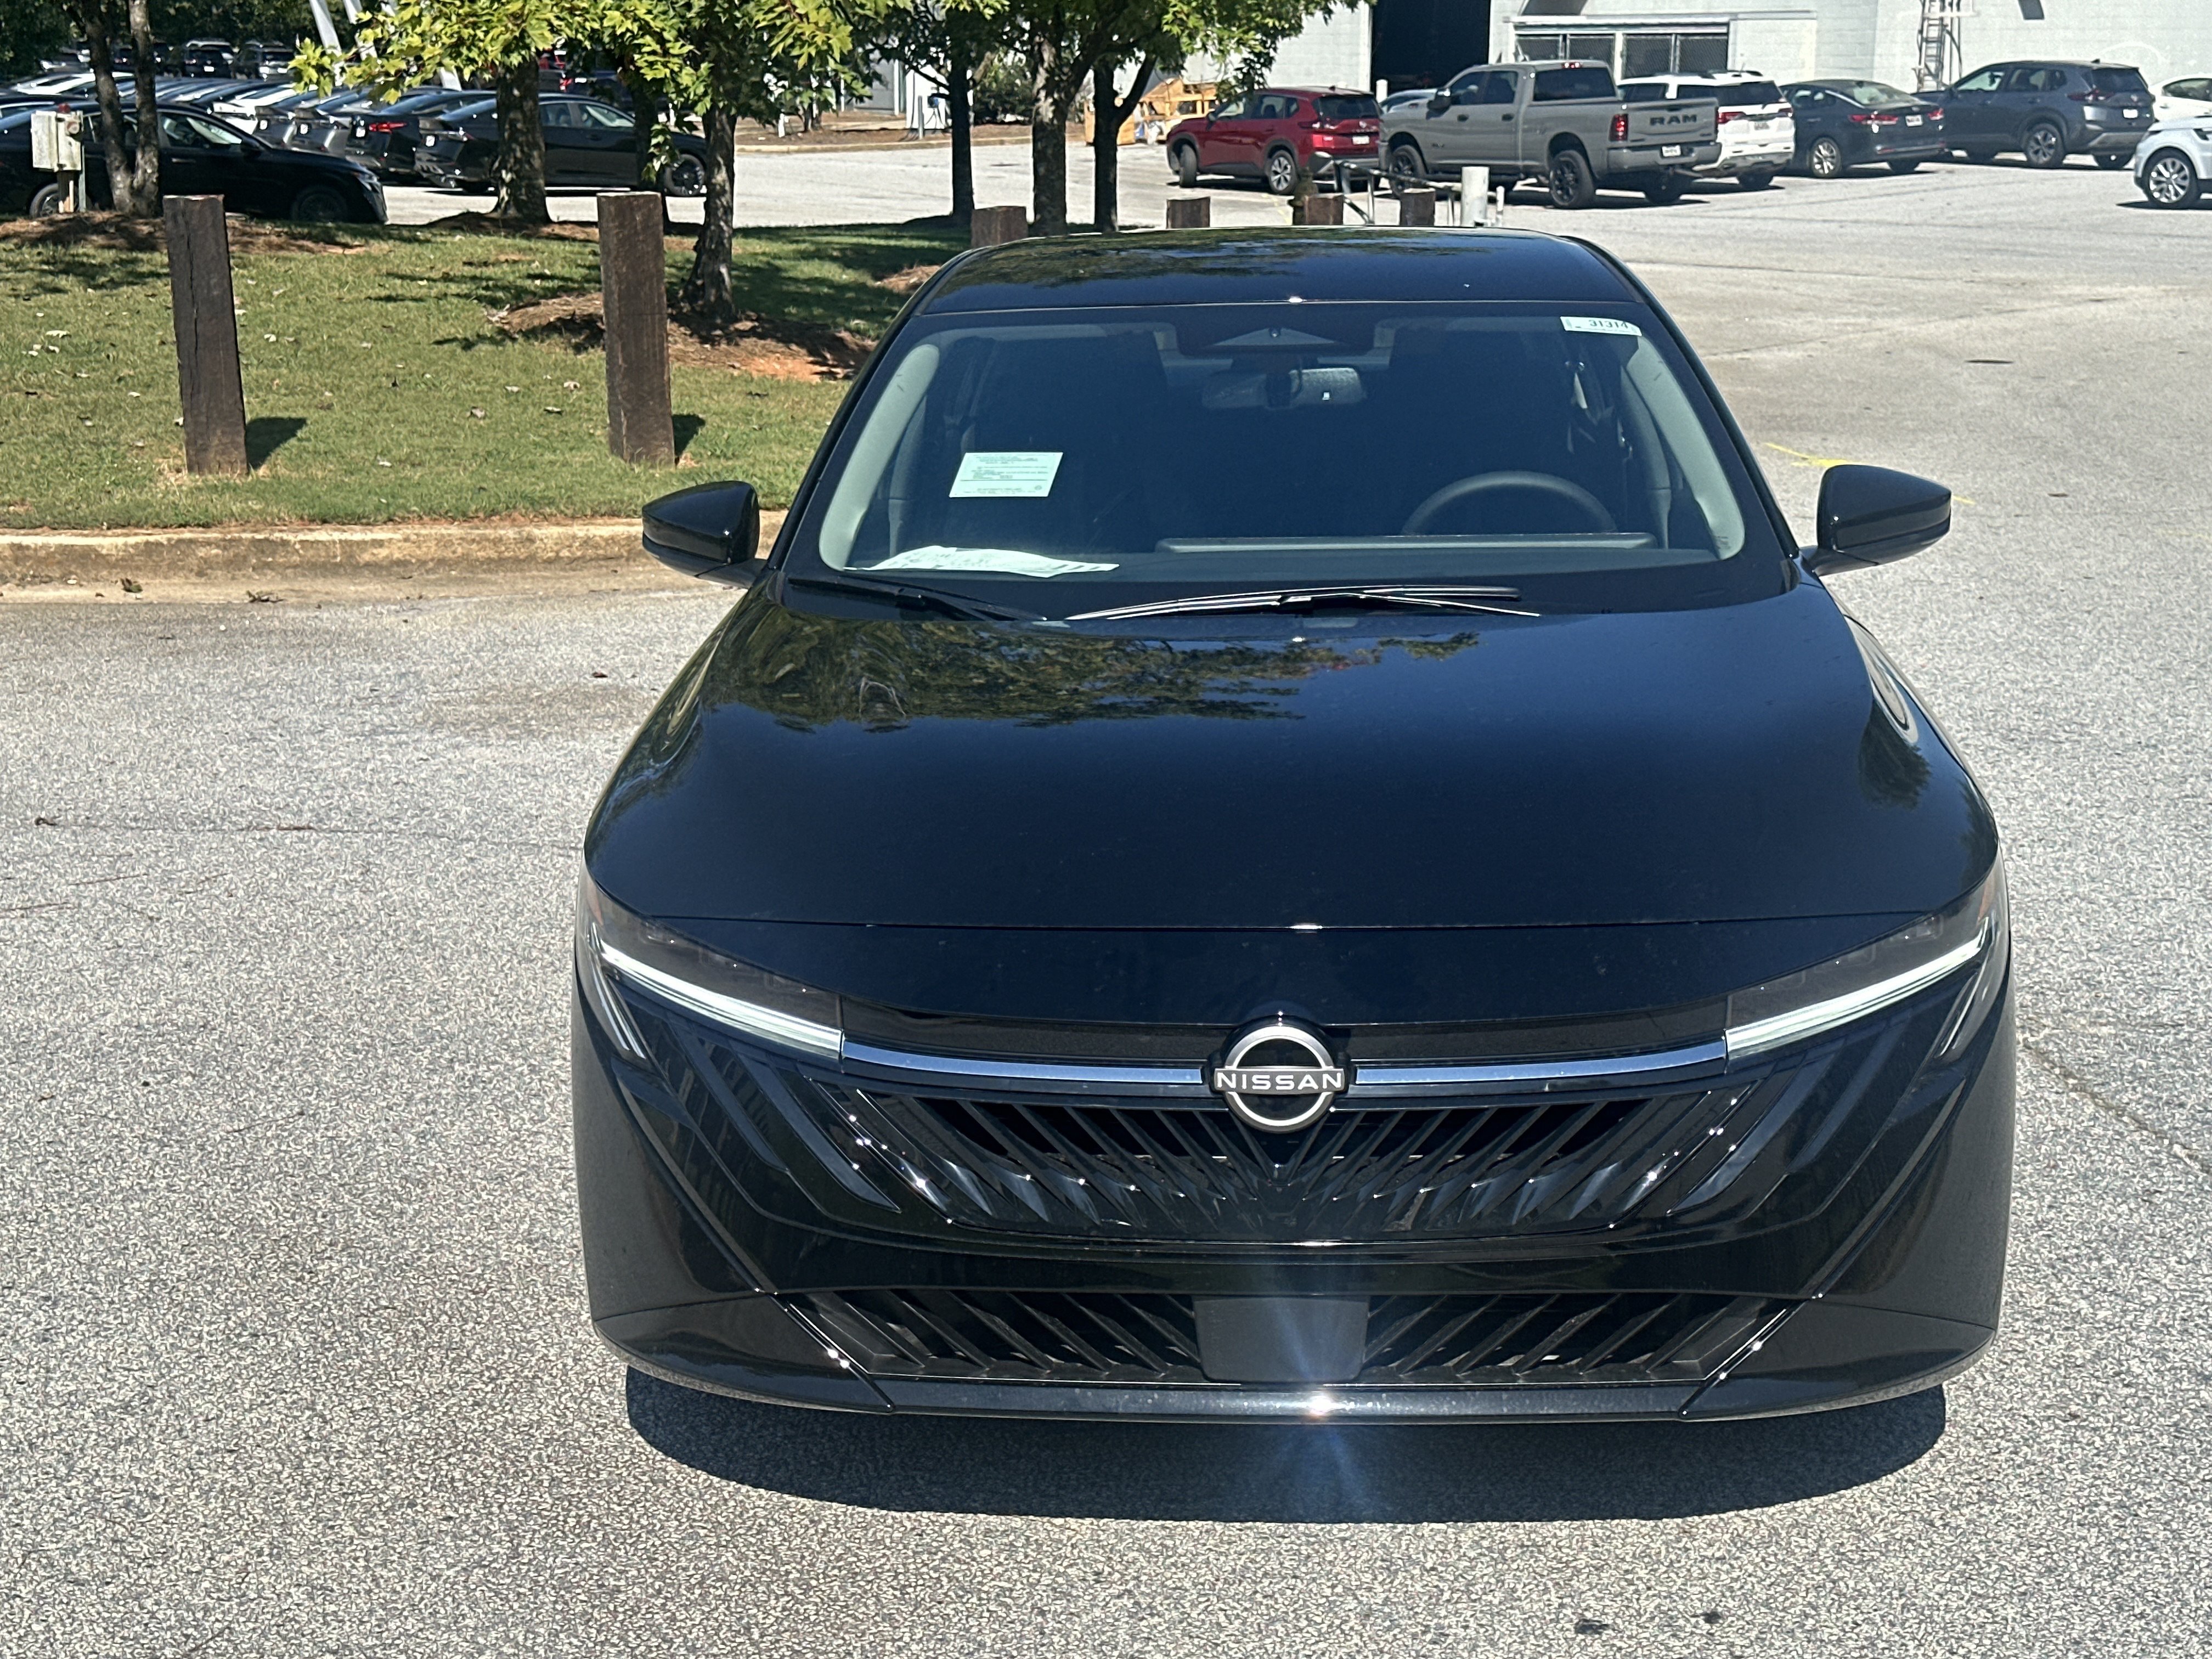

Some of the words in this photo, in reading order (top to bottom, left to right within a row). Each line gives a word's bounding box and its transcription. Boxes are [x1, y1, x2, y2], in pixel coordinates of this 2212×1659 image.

[1650, 114, 1697, 126] RAM
[1588, 319, 1629, 329] 31314
[1217, 1072, 1342, 1090] NISSAN
